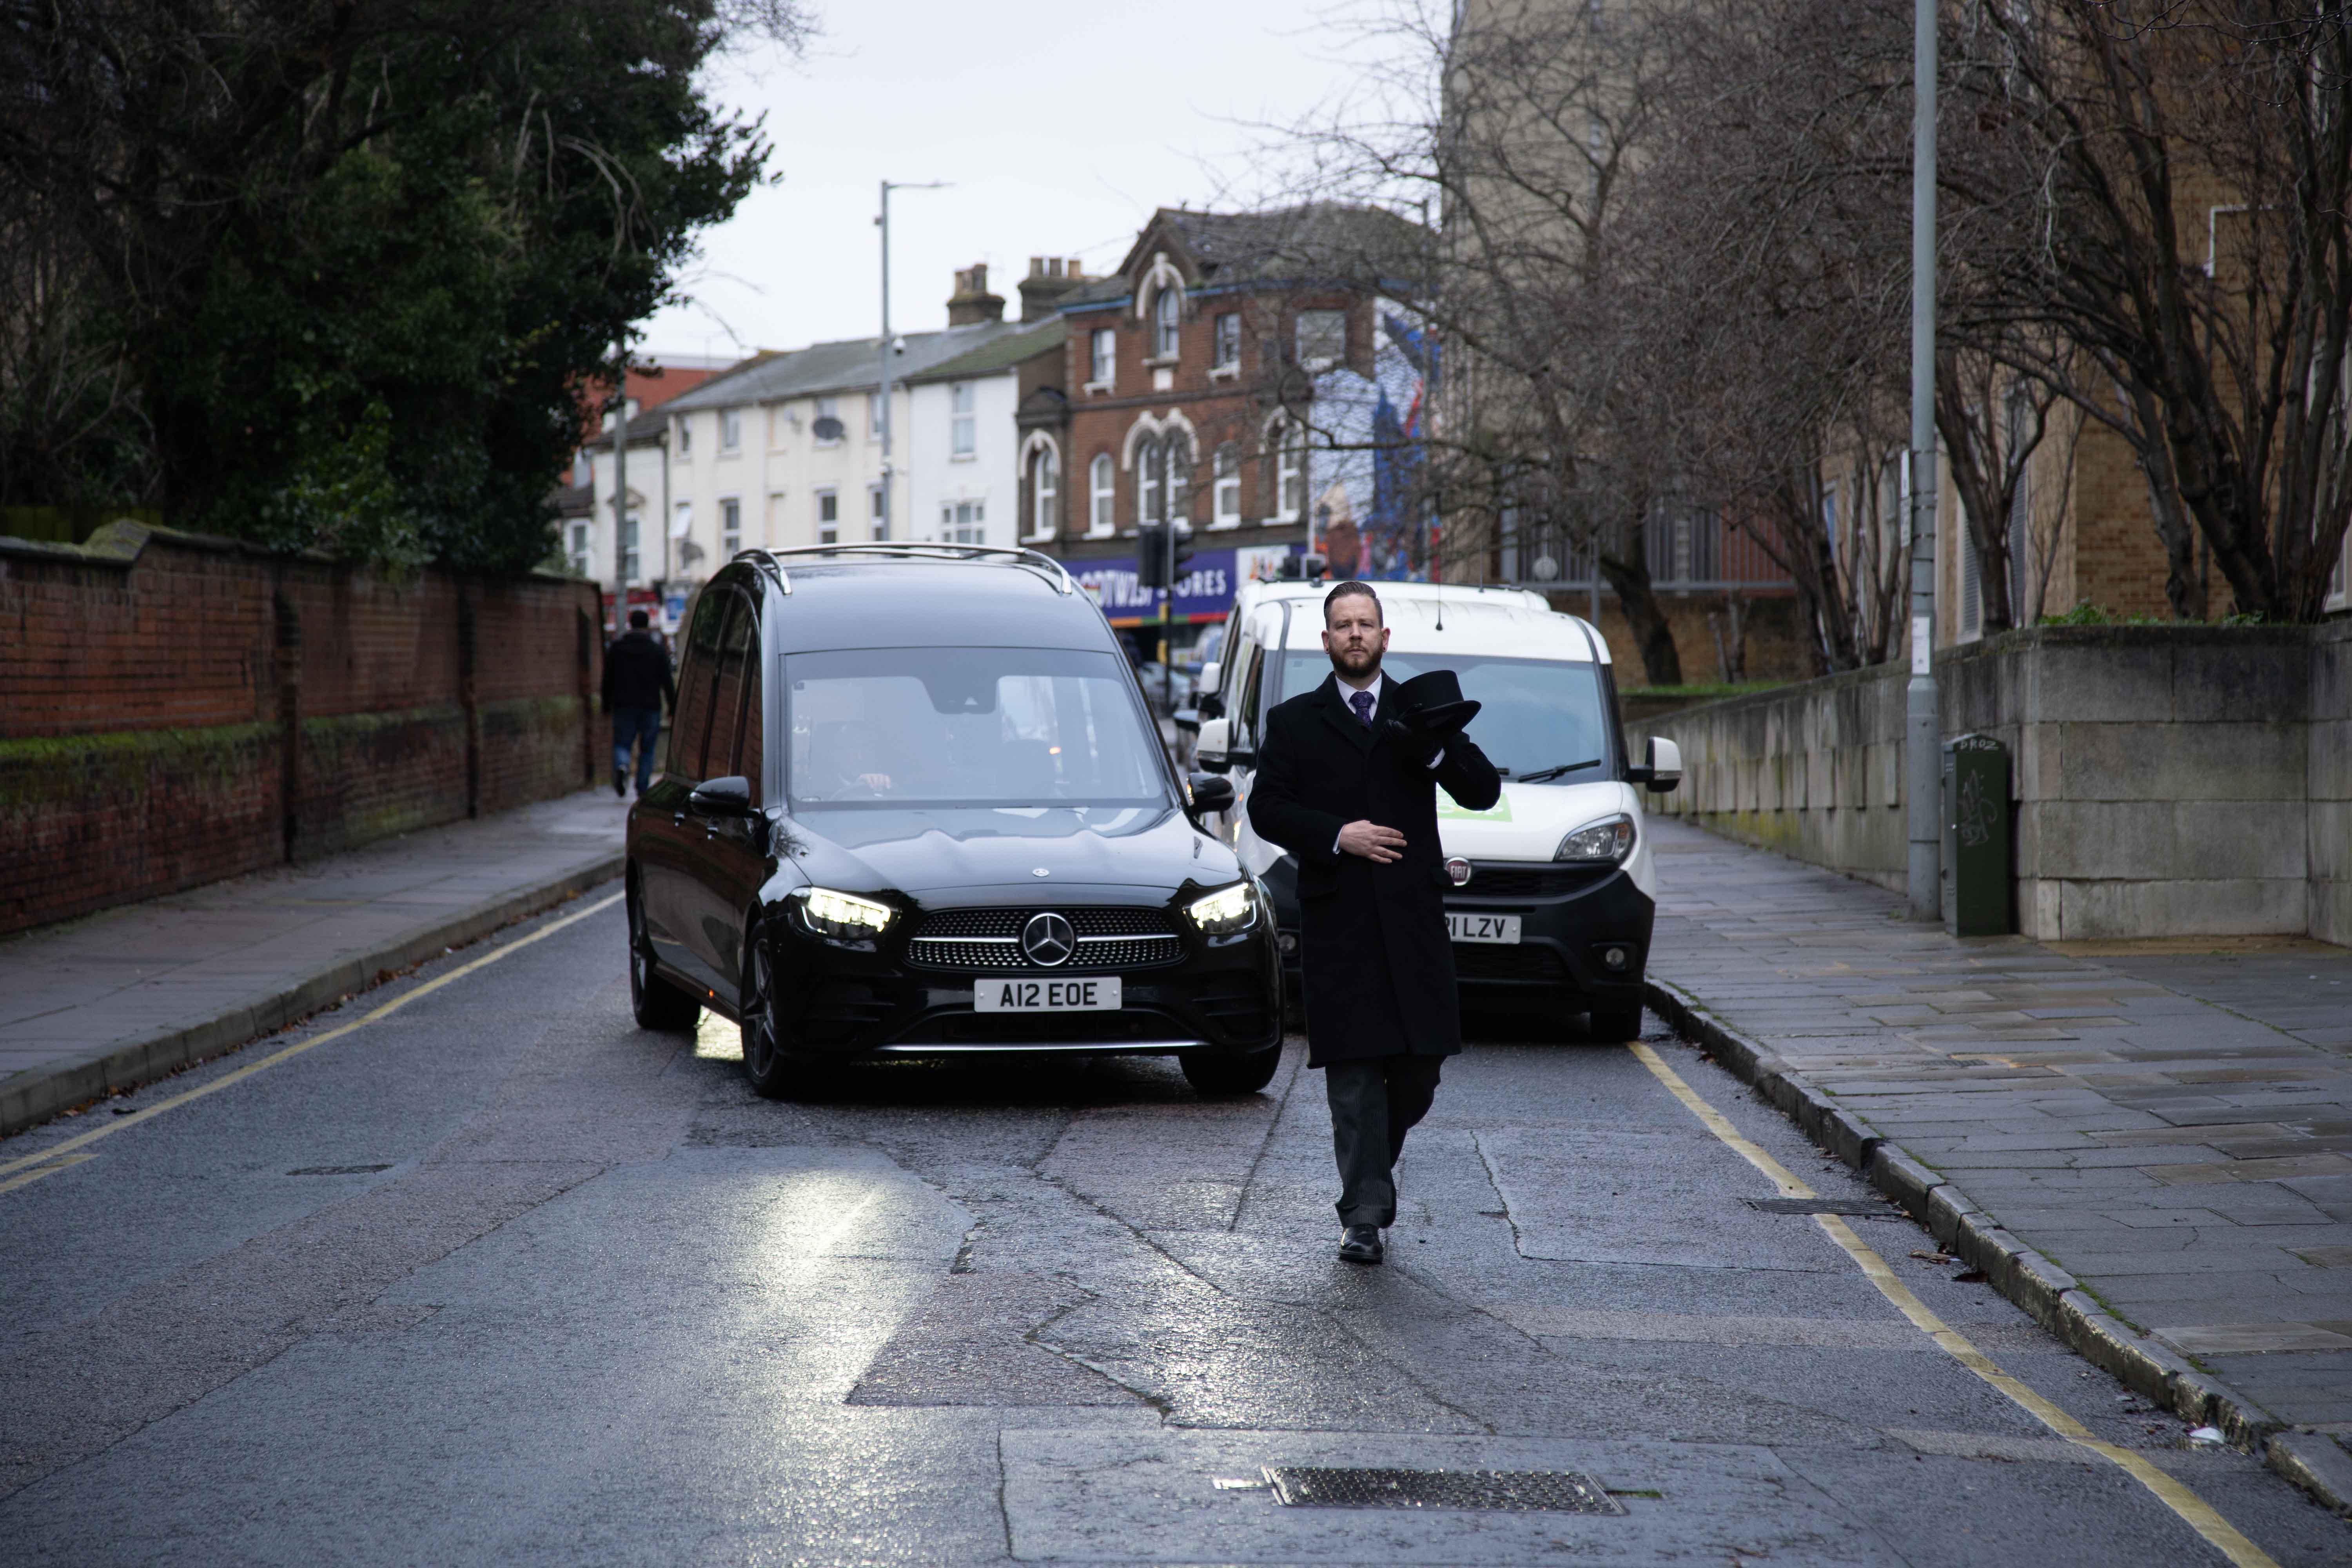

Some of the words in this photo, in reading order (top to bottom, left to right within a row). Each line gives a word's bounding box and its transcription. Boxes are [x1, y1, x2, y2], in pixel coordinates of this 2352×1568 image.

[1450, 866, 1467, 878] FIAT
[1463, 917, 1506, 938] LZV
[1000, 984, 1040, 1007] A12
[1049, 983, 1097, 1006] EOE
